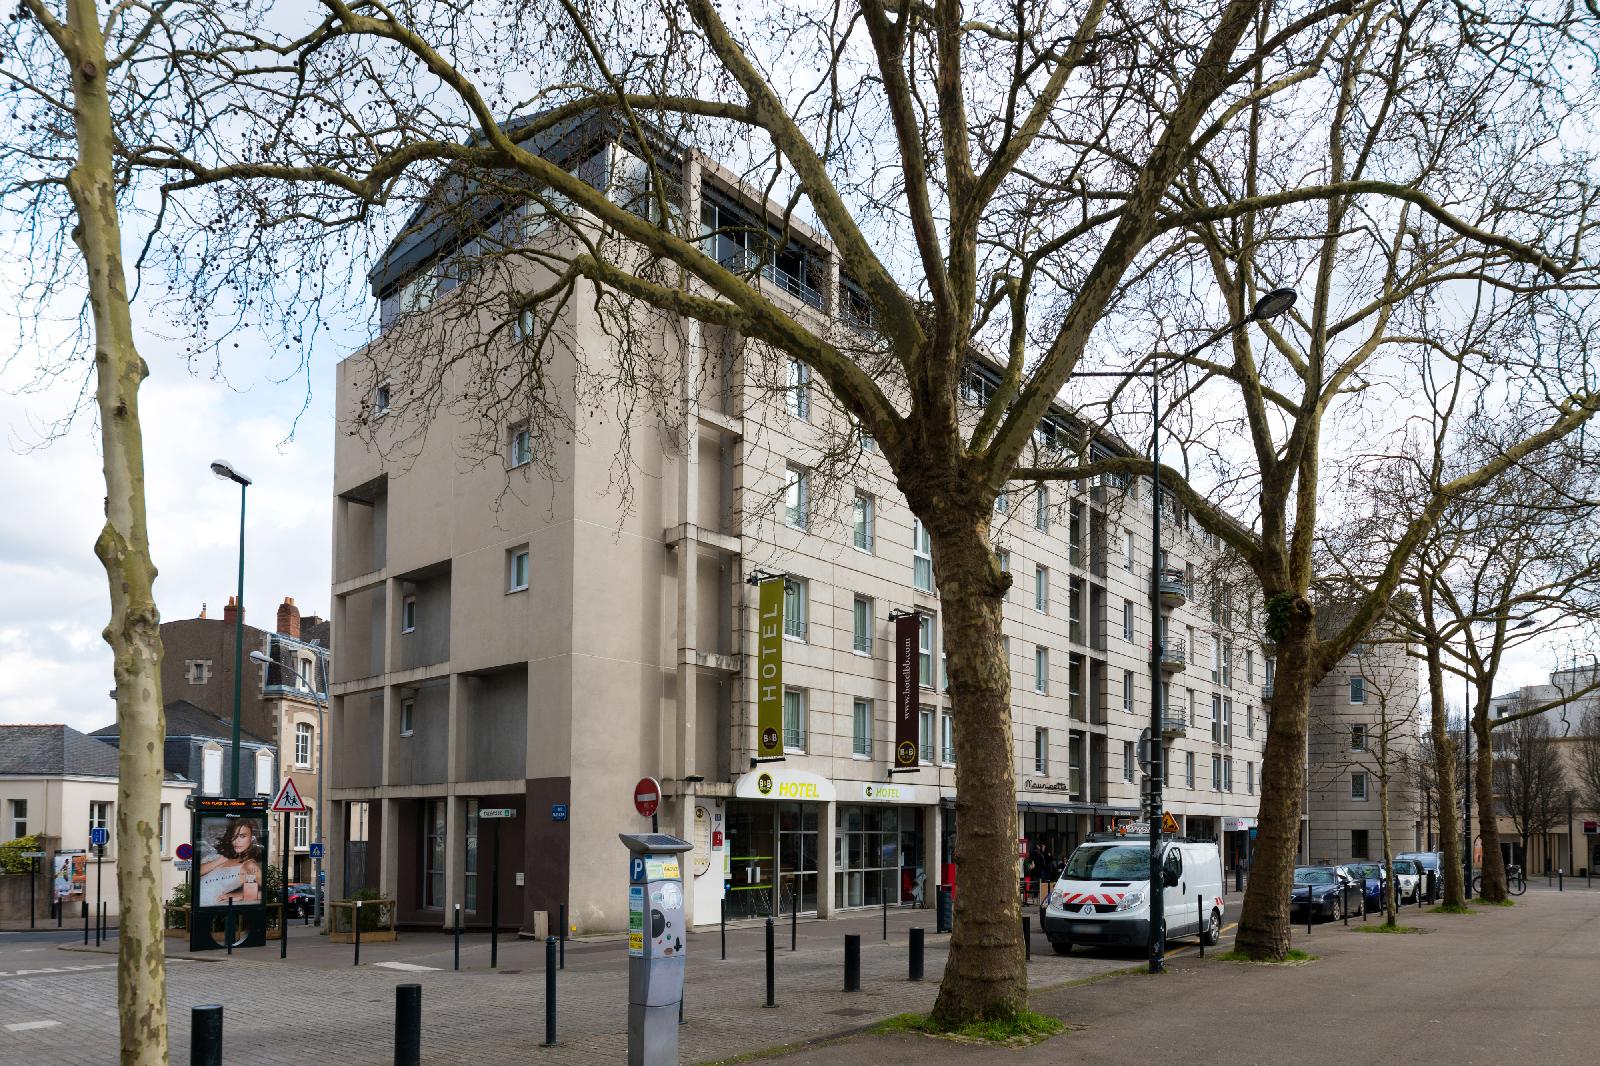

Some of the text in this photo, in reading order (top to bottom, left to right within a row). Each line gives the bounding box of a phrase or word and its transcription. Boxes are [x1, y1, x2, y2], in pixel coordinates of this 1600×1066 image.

[762, 603, 778, 702] HOTEL
[902, 637, 911, 721] www.hotelbb.com
[779, 782, 820, 798] HOTEL
[875, 787, 901, 799] HOTEL
[633, 858, 643, 880] P
